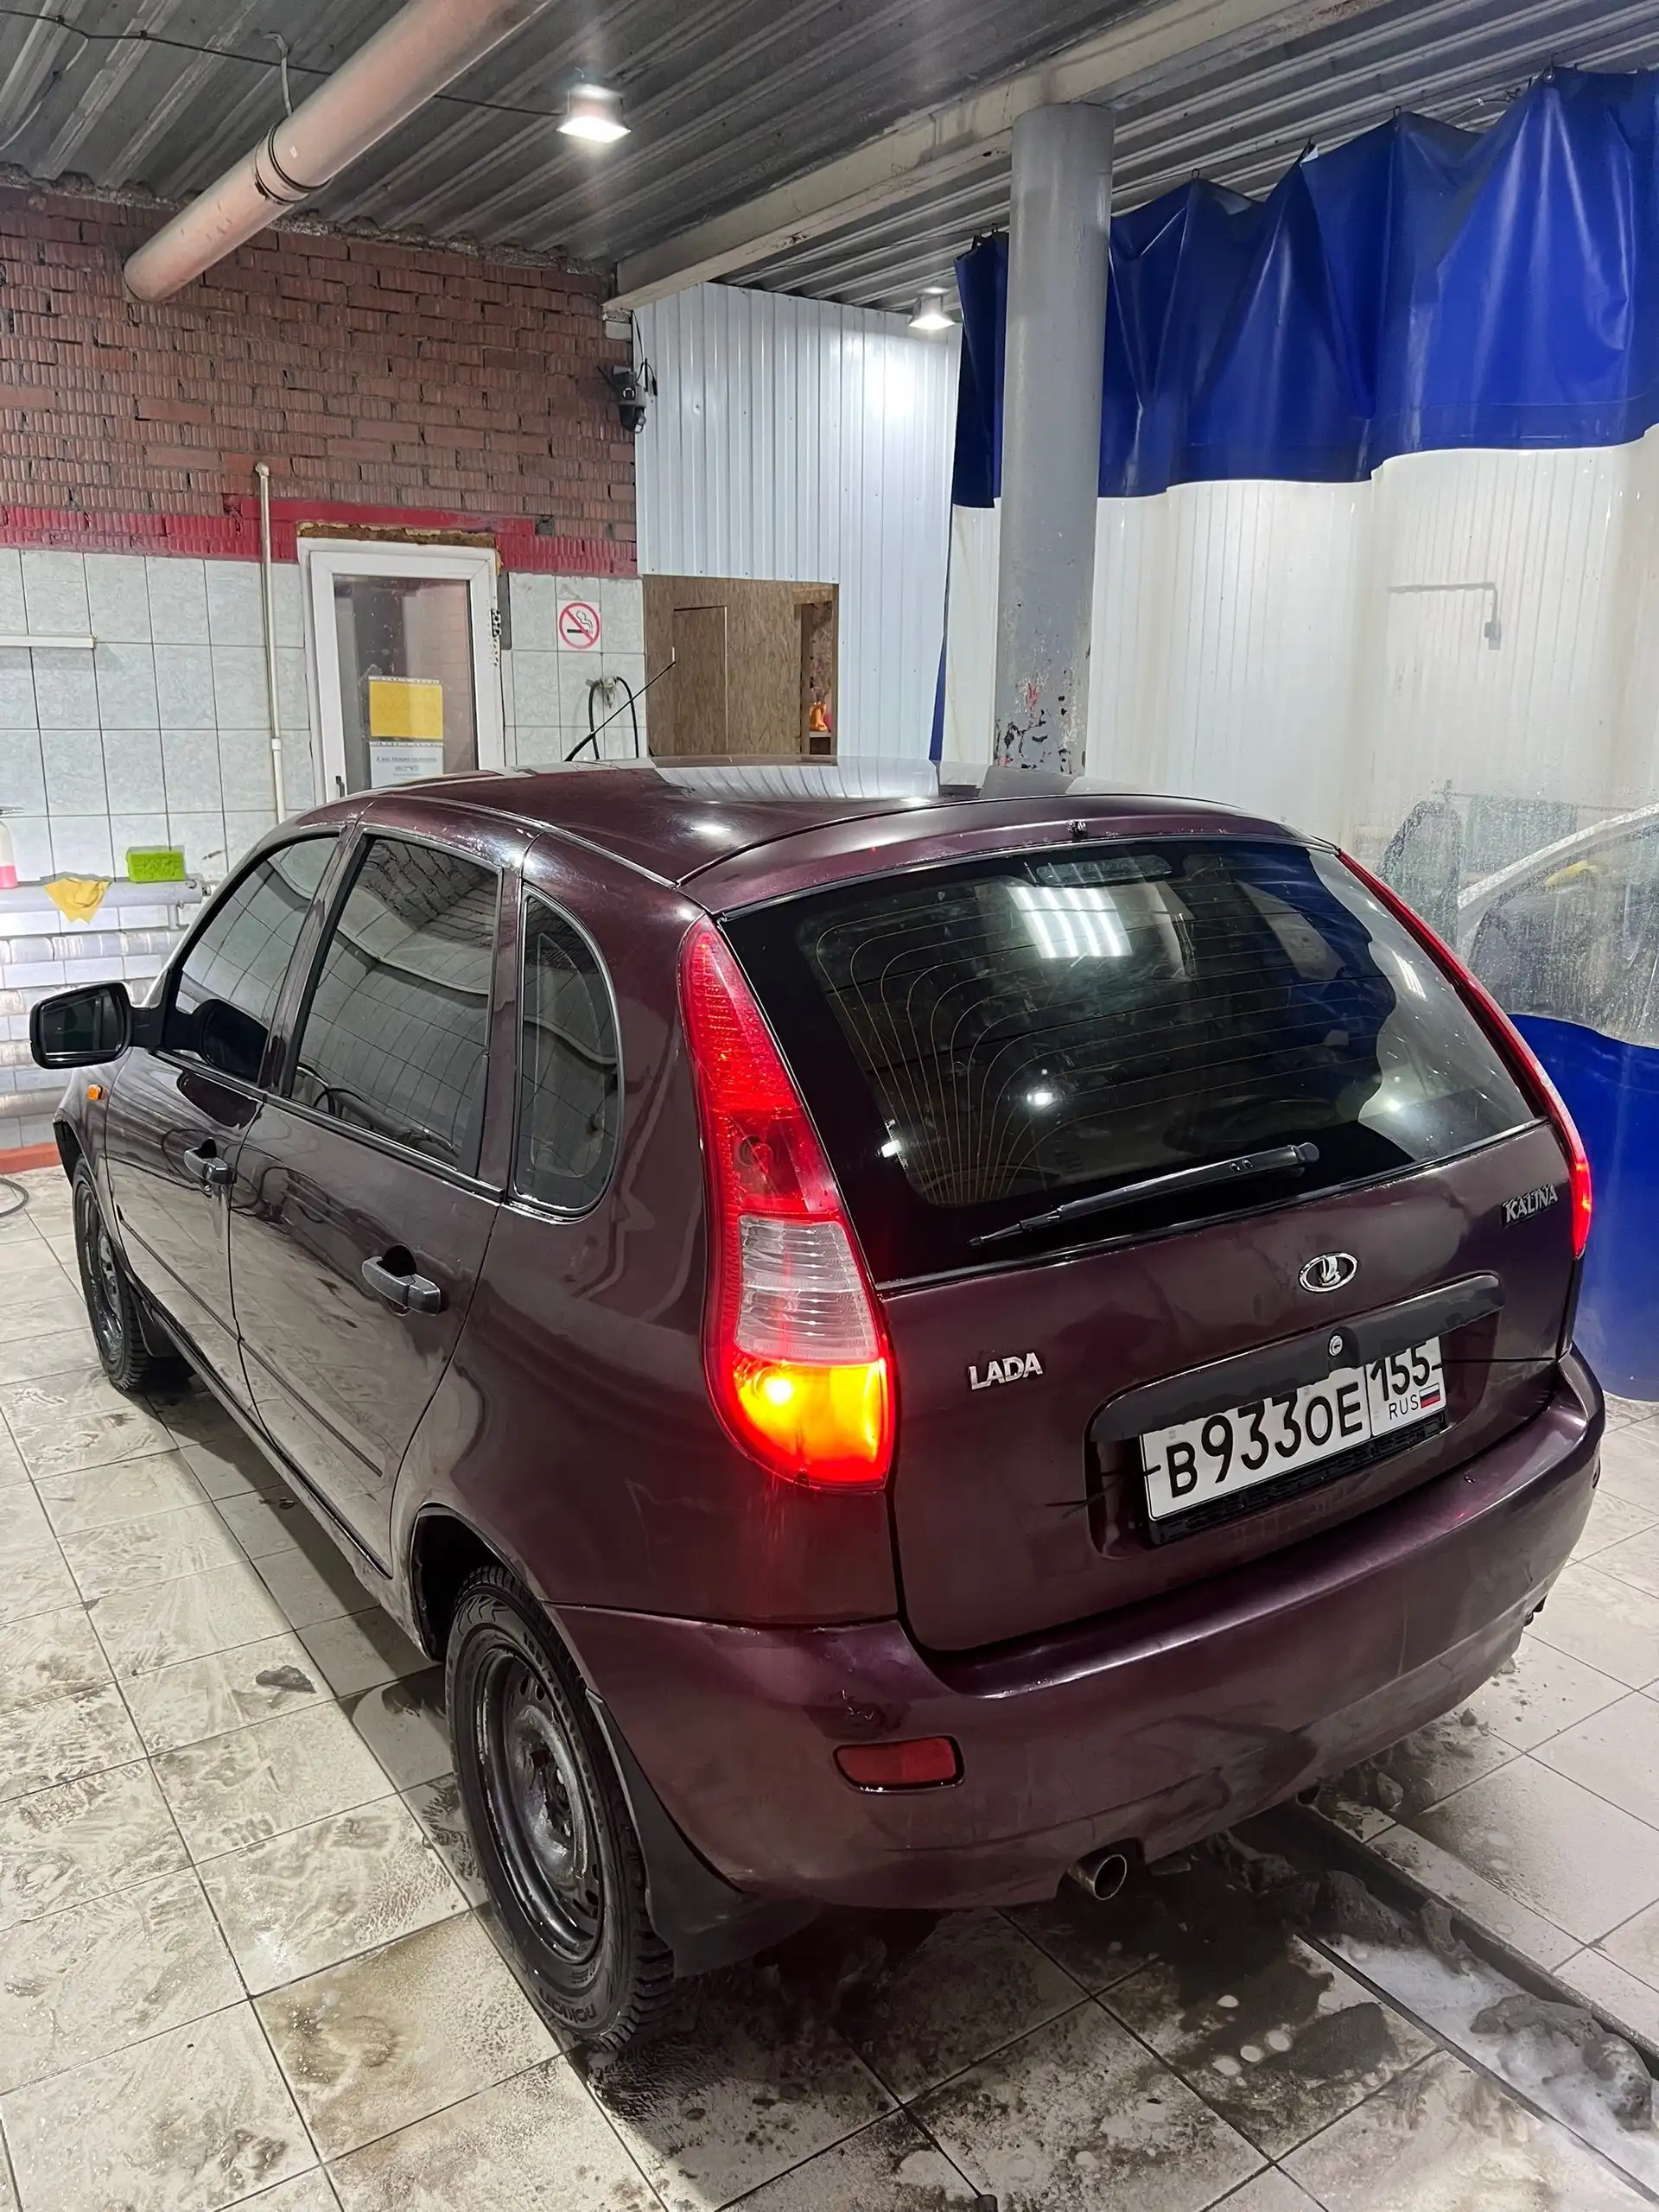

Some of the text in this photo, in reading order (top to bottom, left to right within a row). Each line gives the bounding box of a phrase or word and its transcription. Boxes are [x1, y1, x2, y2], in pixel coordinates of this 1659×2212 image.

[1503, 1183, 1559, 1224] KALINA
[968, 1351, 1044, 1390] LADA
[1370, 1343, 1432, 1402] 155
[1389, 1392, 1420, 1421] RUS
